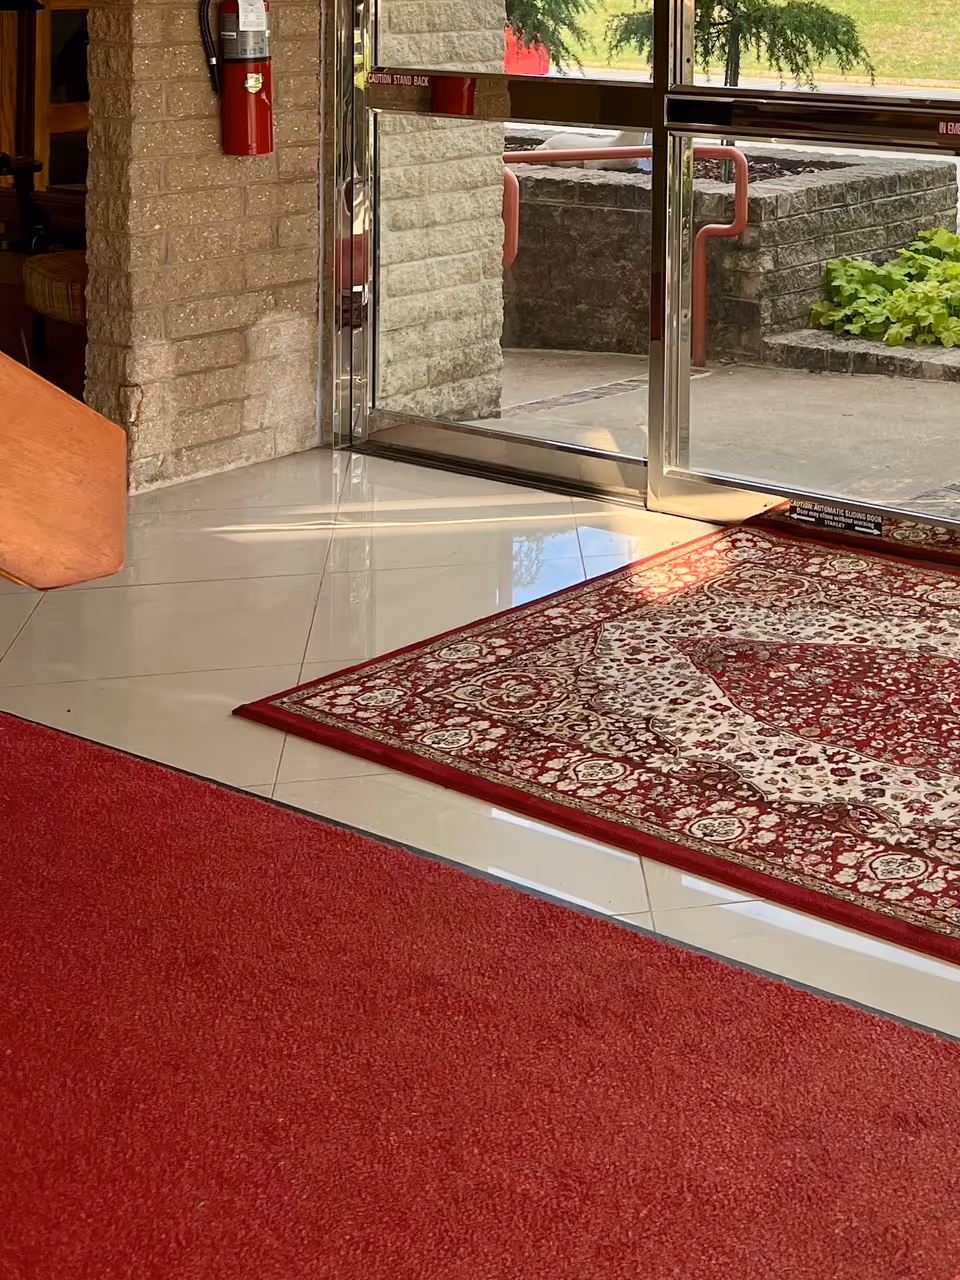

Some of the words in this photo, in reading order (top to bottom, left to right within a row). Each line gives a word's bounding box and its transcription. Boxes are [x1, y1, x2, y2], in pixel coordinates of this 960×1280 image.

[368, 73, 391, 85] CAUTION
[393, 75, 412, 86] STAND
[413, 76, 430, 87] BACK
[939, 121, 947, 134] IN
[796, 507, 808, 515] Door
[809, 510, 819, 518] may
[820, 512, 834, 520] close
[834, 515, 853, 524] without
[853, 519, 875, 530] warning
[813, 504, 845, 516] AUTOMATIC
[845, 510, 866, 521] SLIDING
[866, 514, 882, 523] DOOR
[824, 520, 845, 528] STANLEY
